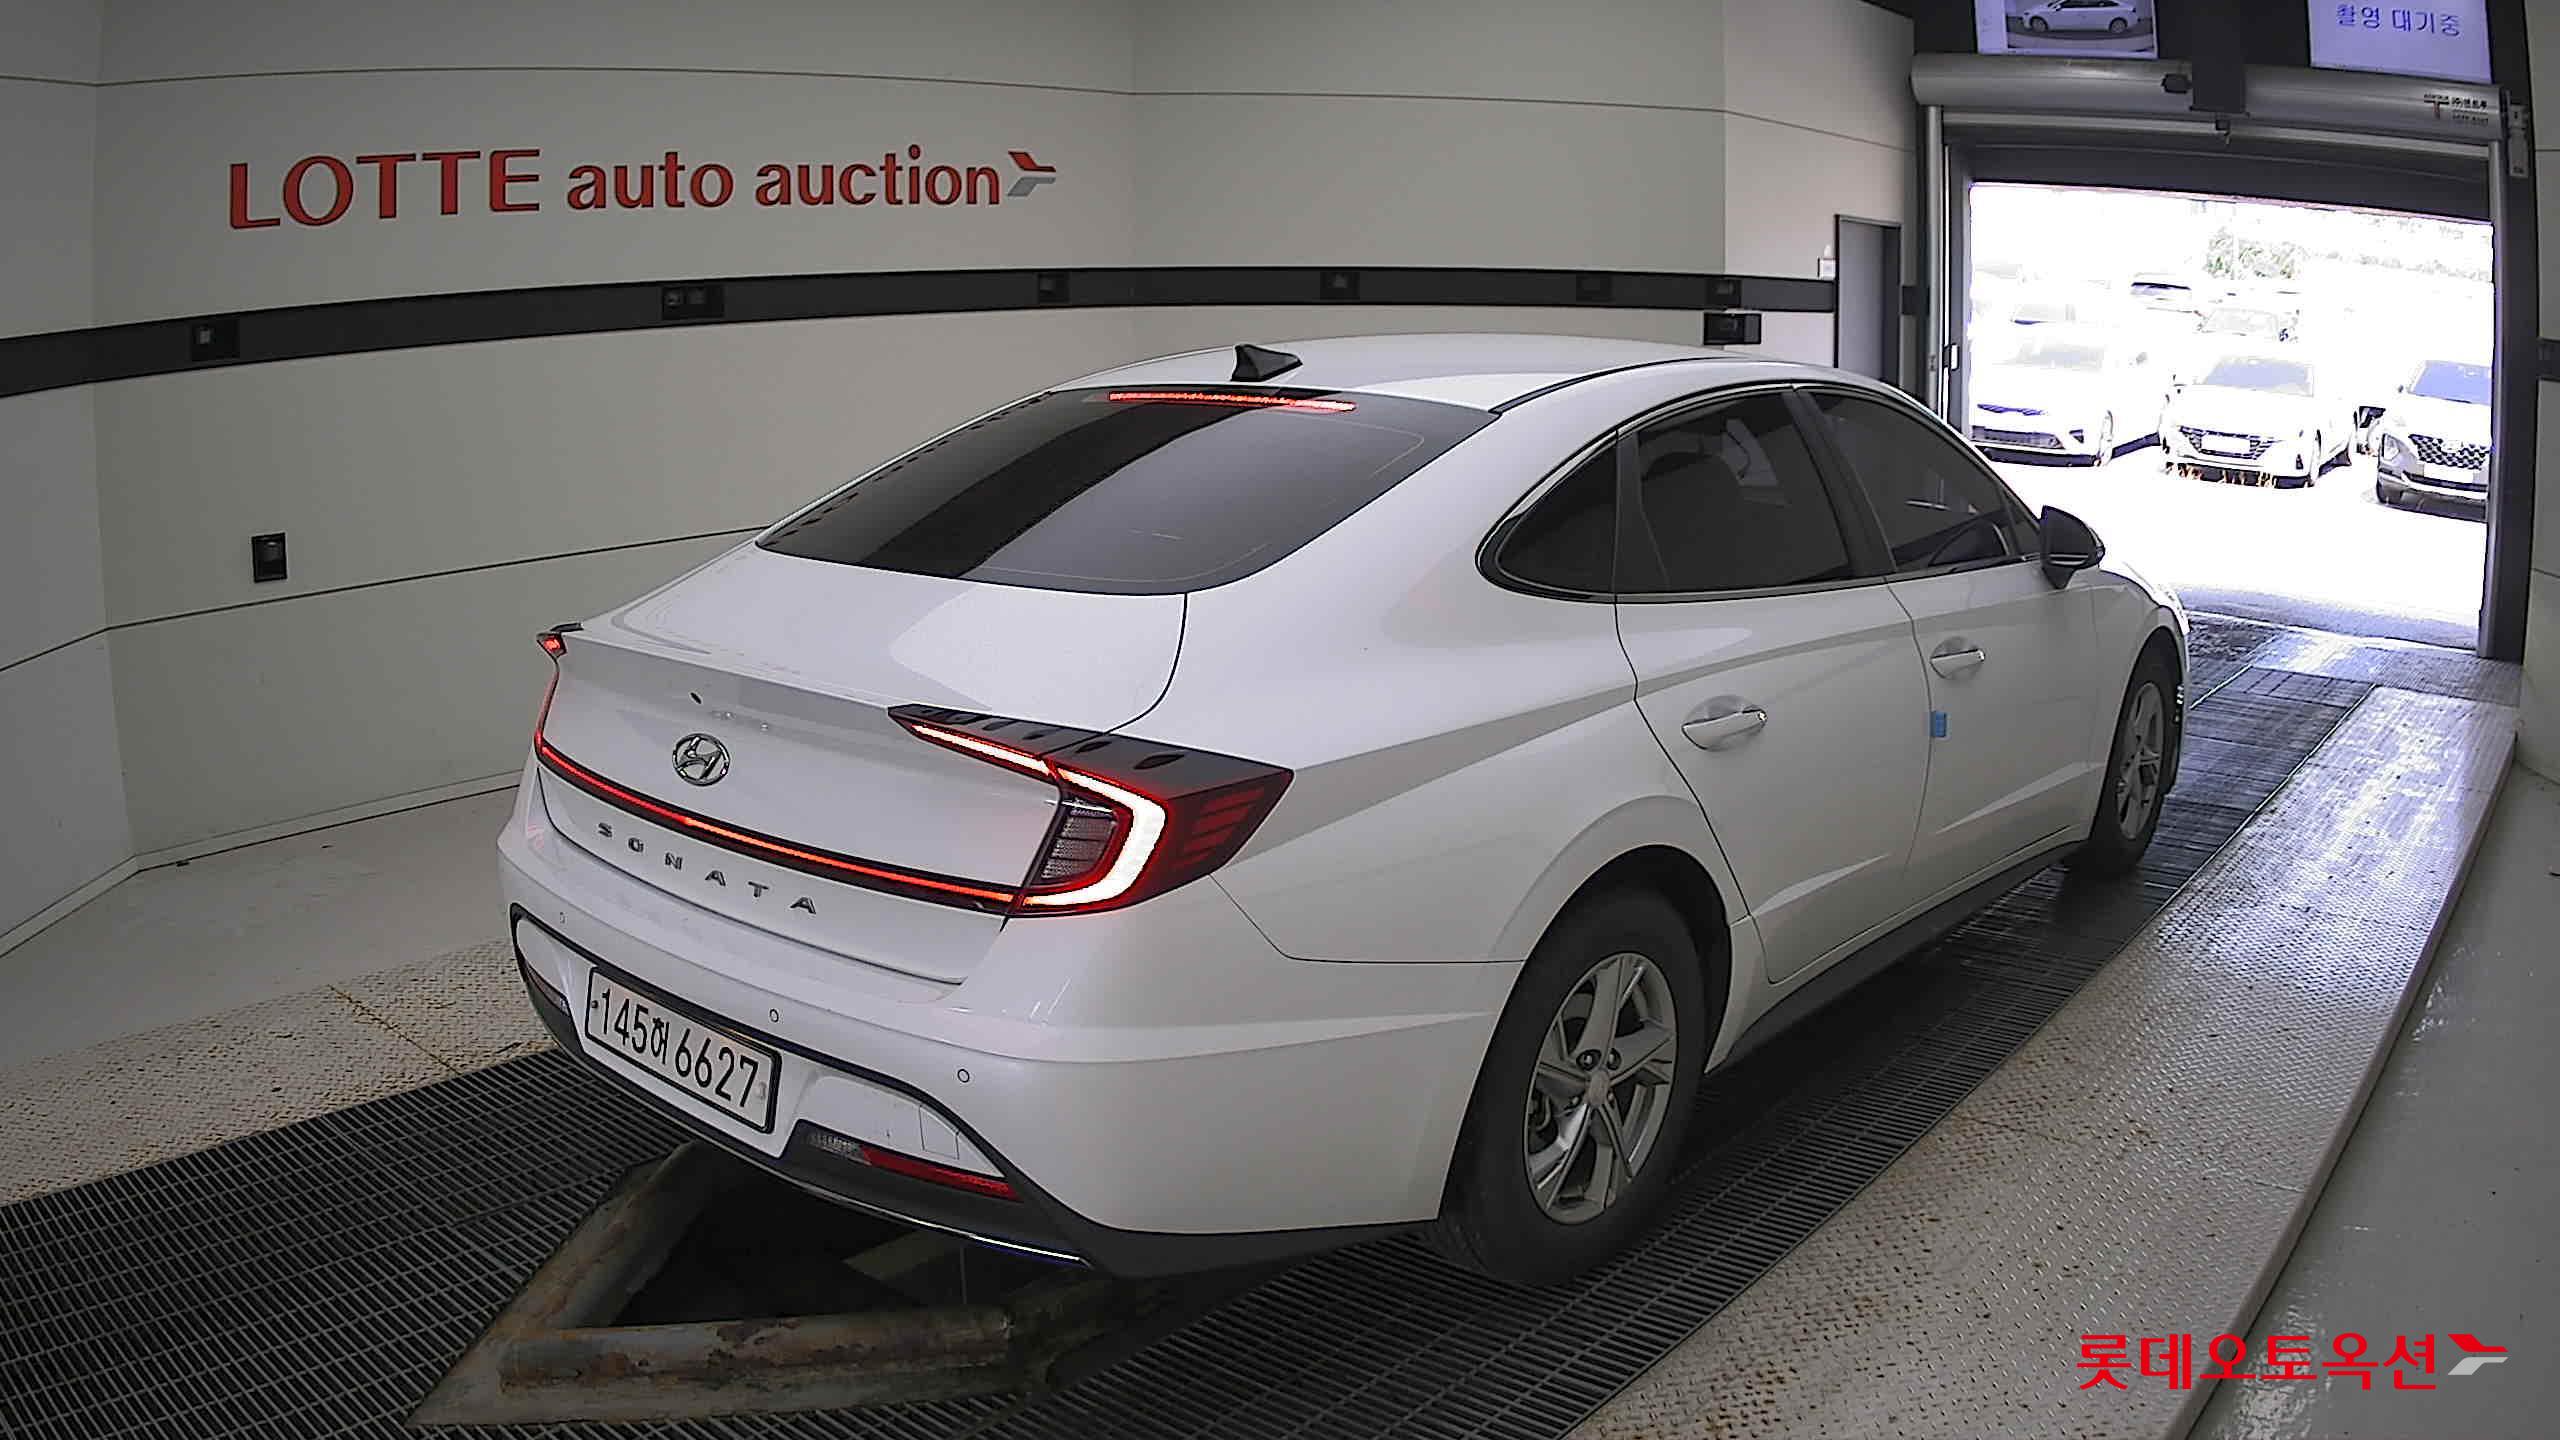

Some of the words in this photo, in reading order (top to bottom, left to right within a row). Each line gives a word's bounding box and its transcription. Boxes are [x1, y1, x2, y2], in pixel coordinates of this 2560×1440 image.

[2336, 3, 2381, 30] 촬영
[2391, 8, 2461, 38] 대기중
[229, 148, 541, 231] LOTTE
[566, 151, 735, 211] auto
[755, 144, 1001, 207] auction
[597, 821, 817, 916] SONATA
